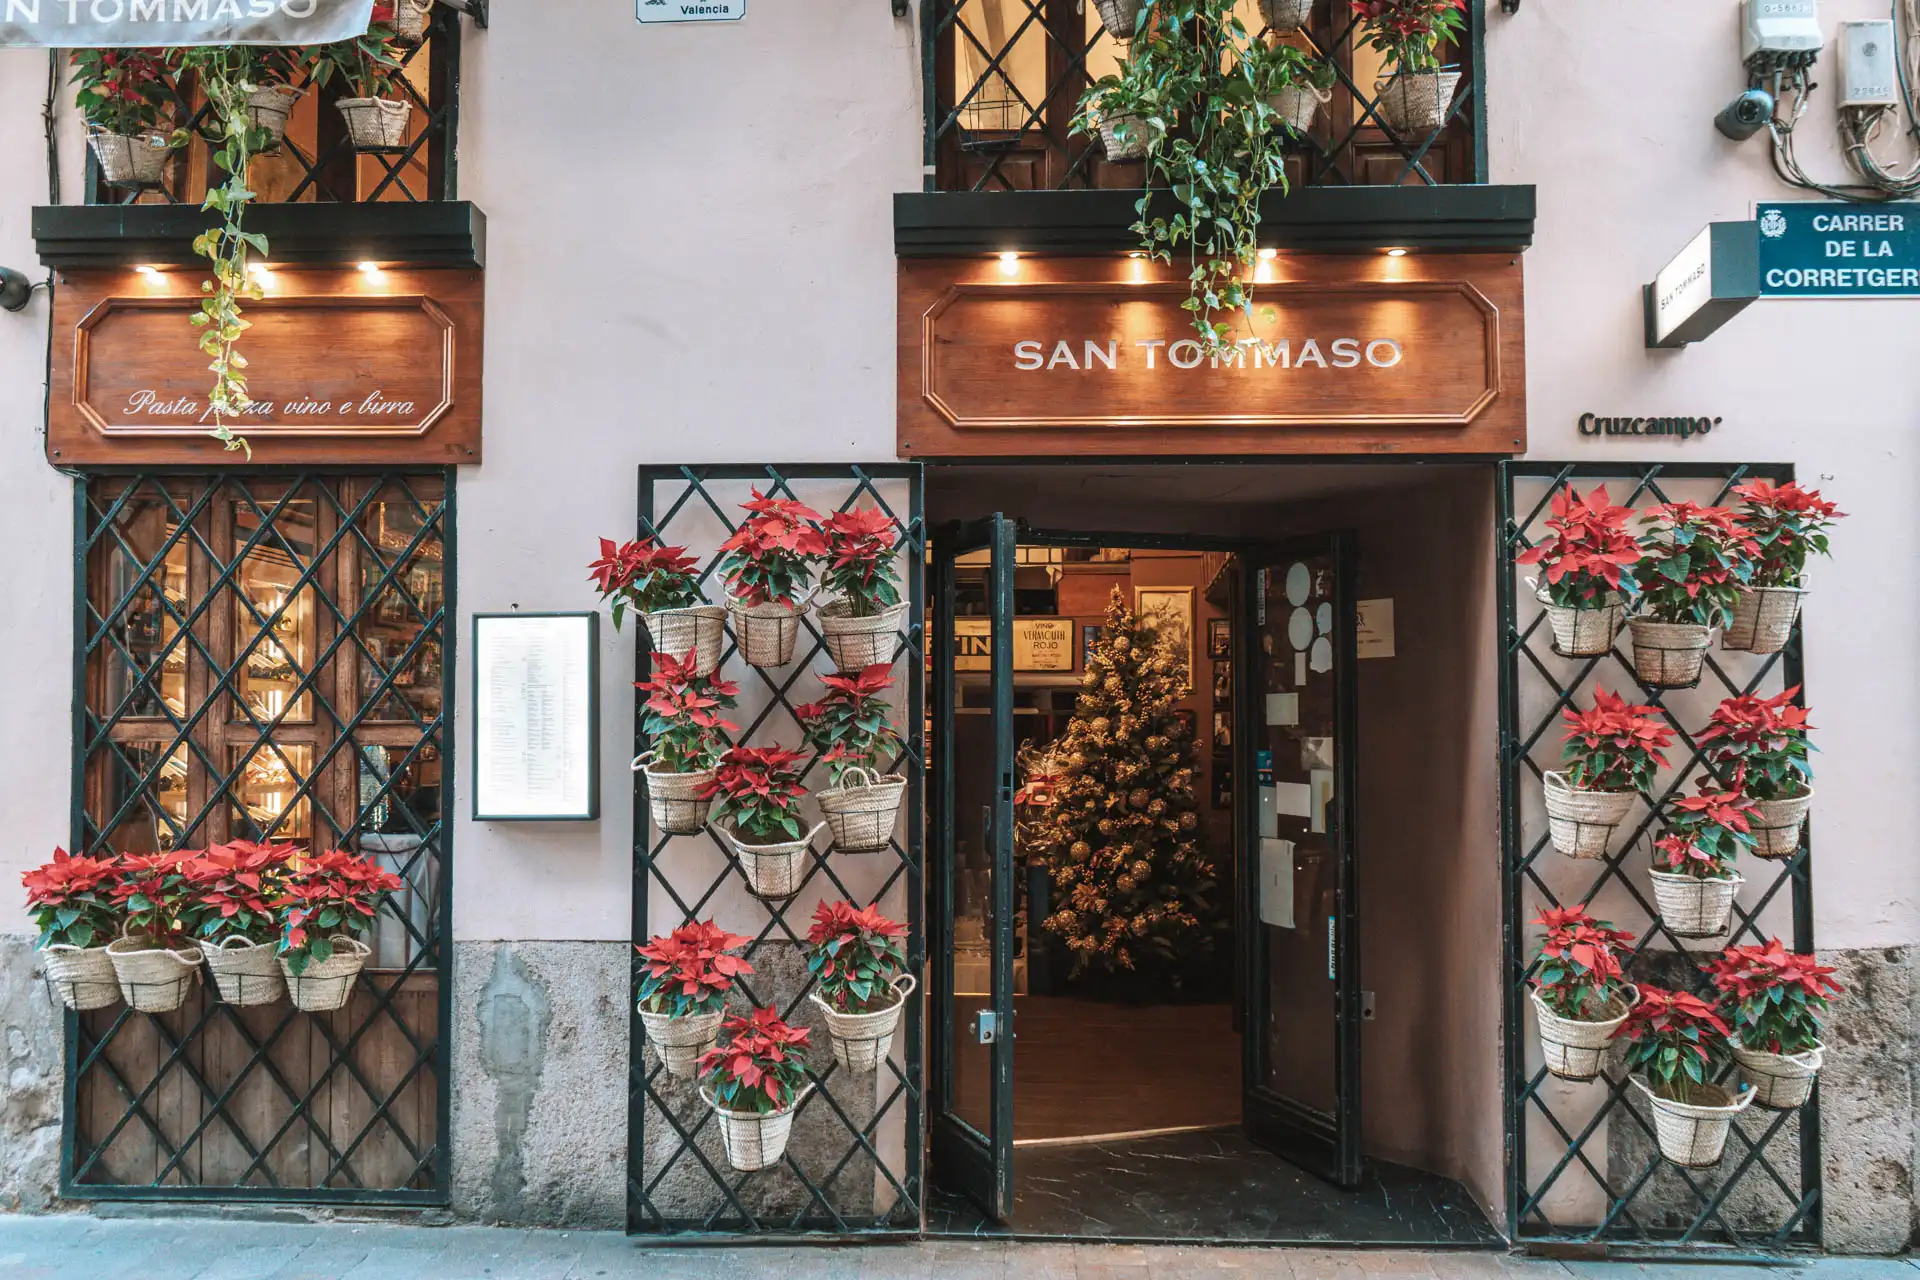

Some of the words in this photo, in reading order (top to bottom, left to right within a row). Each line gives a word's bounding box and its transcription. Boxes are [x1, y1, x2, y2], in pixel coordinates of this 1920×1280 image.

[58, 0, 317, 24] TOMMASO
[680, 4, 729, 15] Valencia
[1812, 214, 1905, 232] CARRER
[1825, 240, 1856, 257] DE
[1863, 240, 1894, 257] LA
[1660, 292, 1674, 311] SAN
[1675, 262, 1706, 294] TOMMASO
[1014, 339, 1117, 370] SAN
[1136, 338, 1403, 369] TOMMASO
[123, 389, 198, 416] Pasta
[283, 396, 332, 416] vino
[338, 400, 353, 416] e
[358, 390, 415, 416] birra
[1578, 412, 1713, 439] Cruzcampo
[1023, 630, 1065, 641] VERMOUTH
[1033, 641, 1058, 650] ROJO
